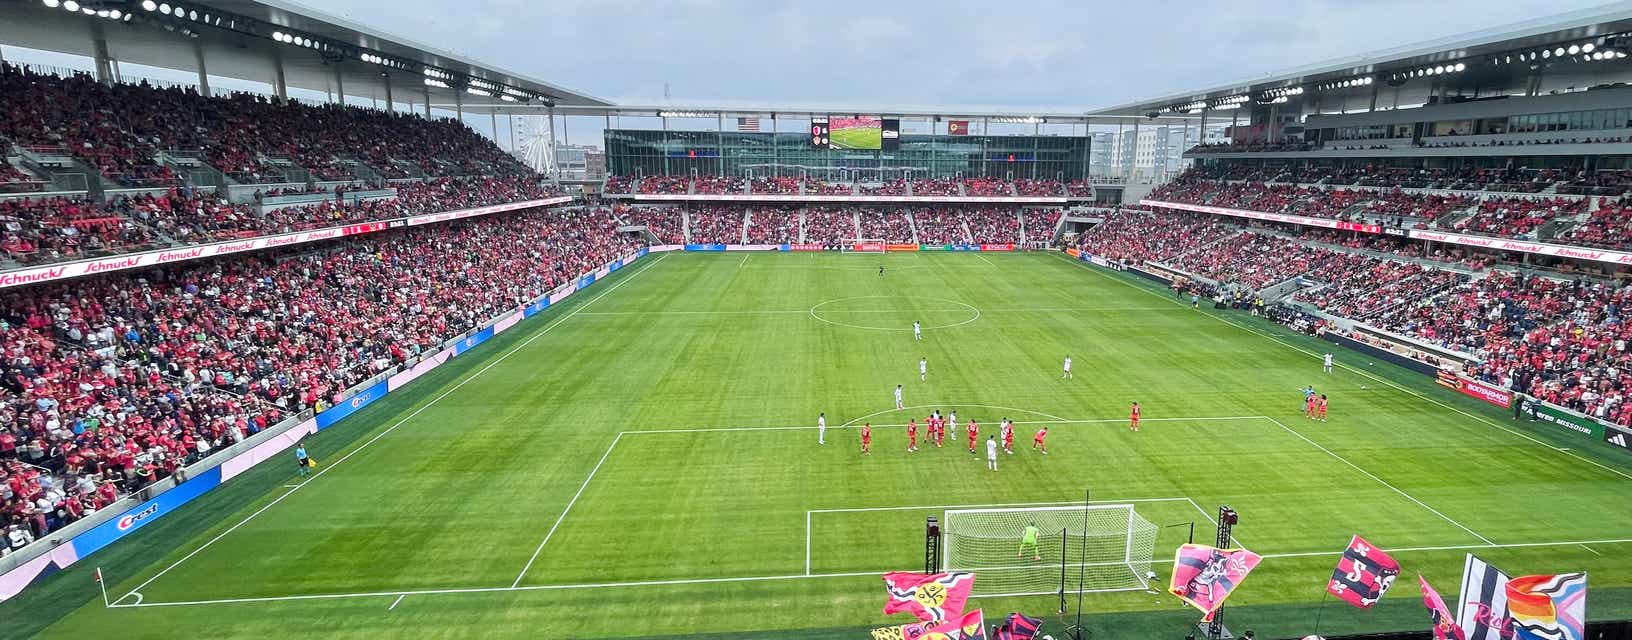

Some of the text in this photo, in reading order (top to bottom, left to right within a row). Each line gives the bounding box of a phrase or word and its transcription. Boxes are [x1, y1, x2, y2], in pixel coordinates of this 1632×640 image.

[215, 240, 255, 254] Schnucks
[264, 235, 299, 247] Schnucks
[1456, 236, 1493, 246] Schnucks
[1503, 242, 1544, 252] Schnucks
[157, 249, 204, 262] Schnucks
[1555, 249, 1605, 259] Schnucks
[84, 257, 142, 273] Schnucks
[0, 268, 66, 284] Schnucks
[1556, 418, 1592, 435] MISSOURI
[118, 503, 159, 530] Crest
